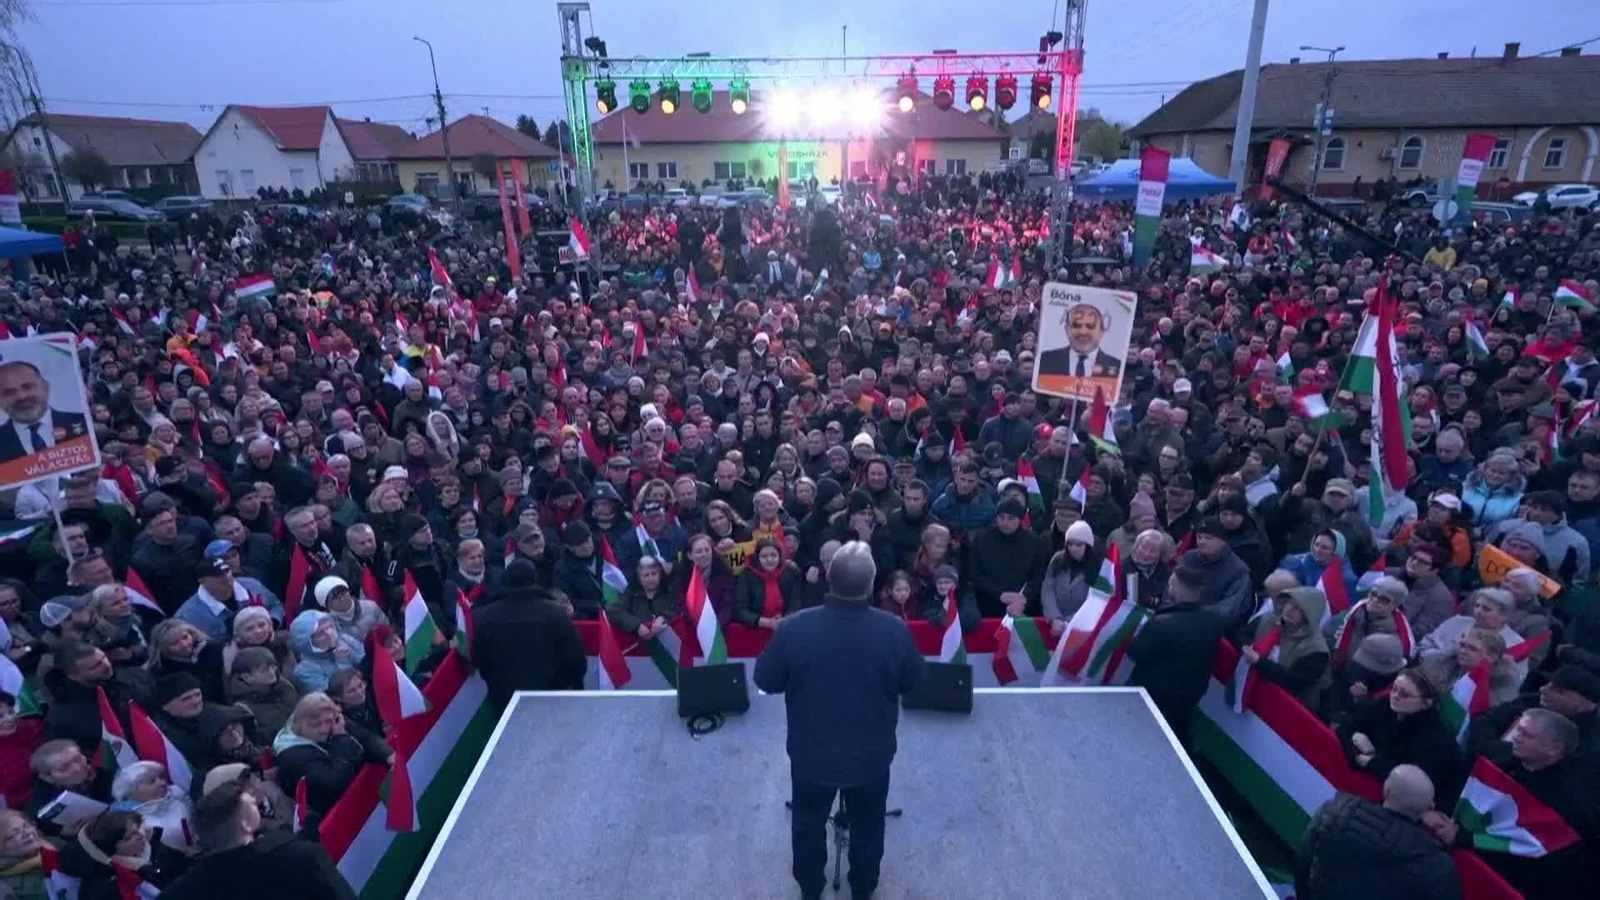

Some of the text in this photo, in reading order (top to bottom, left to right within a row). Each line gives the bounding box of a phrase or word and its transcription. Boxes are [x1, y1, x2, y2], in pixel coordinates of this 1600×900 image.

[1050, 289, 1081, 301] Bóna
[38, 445, 87, 463] A BIZTOS
